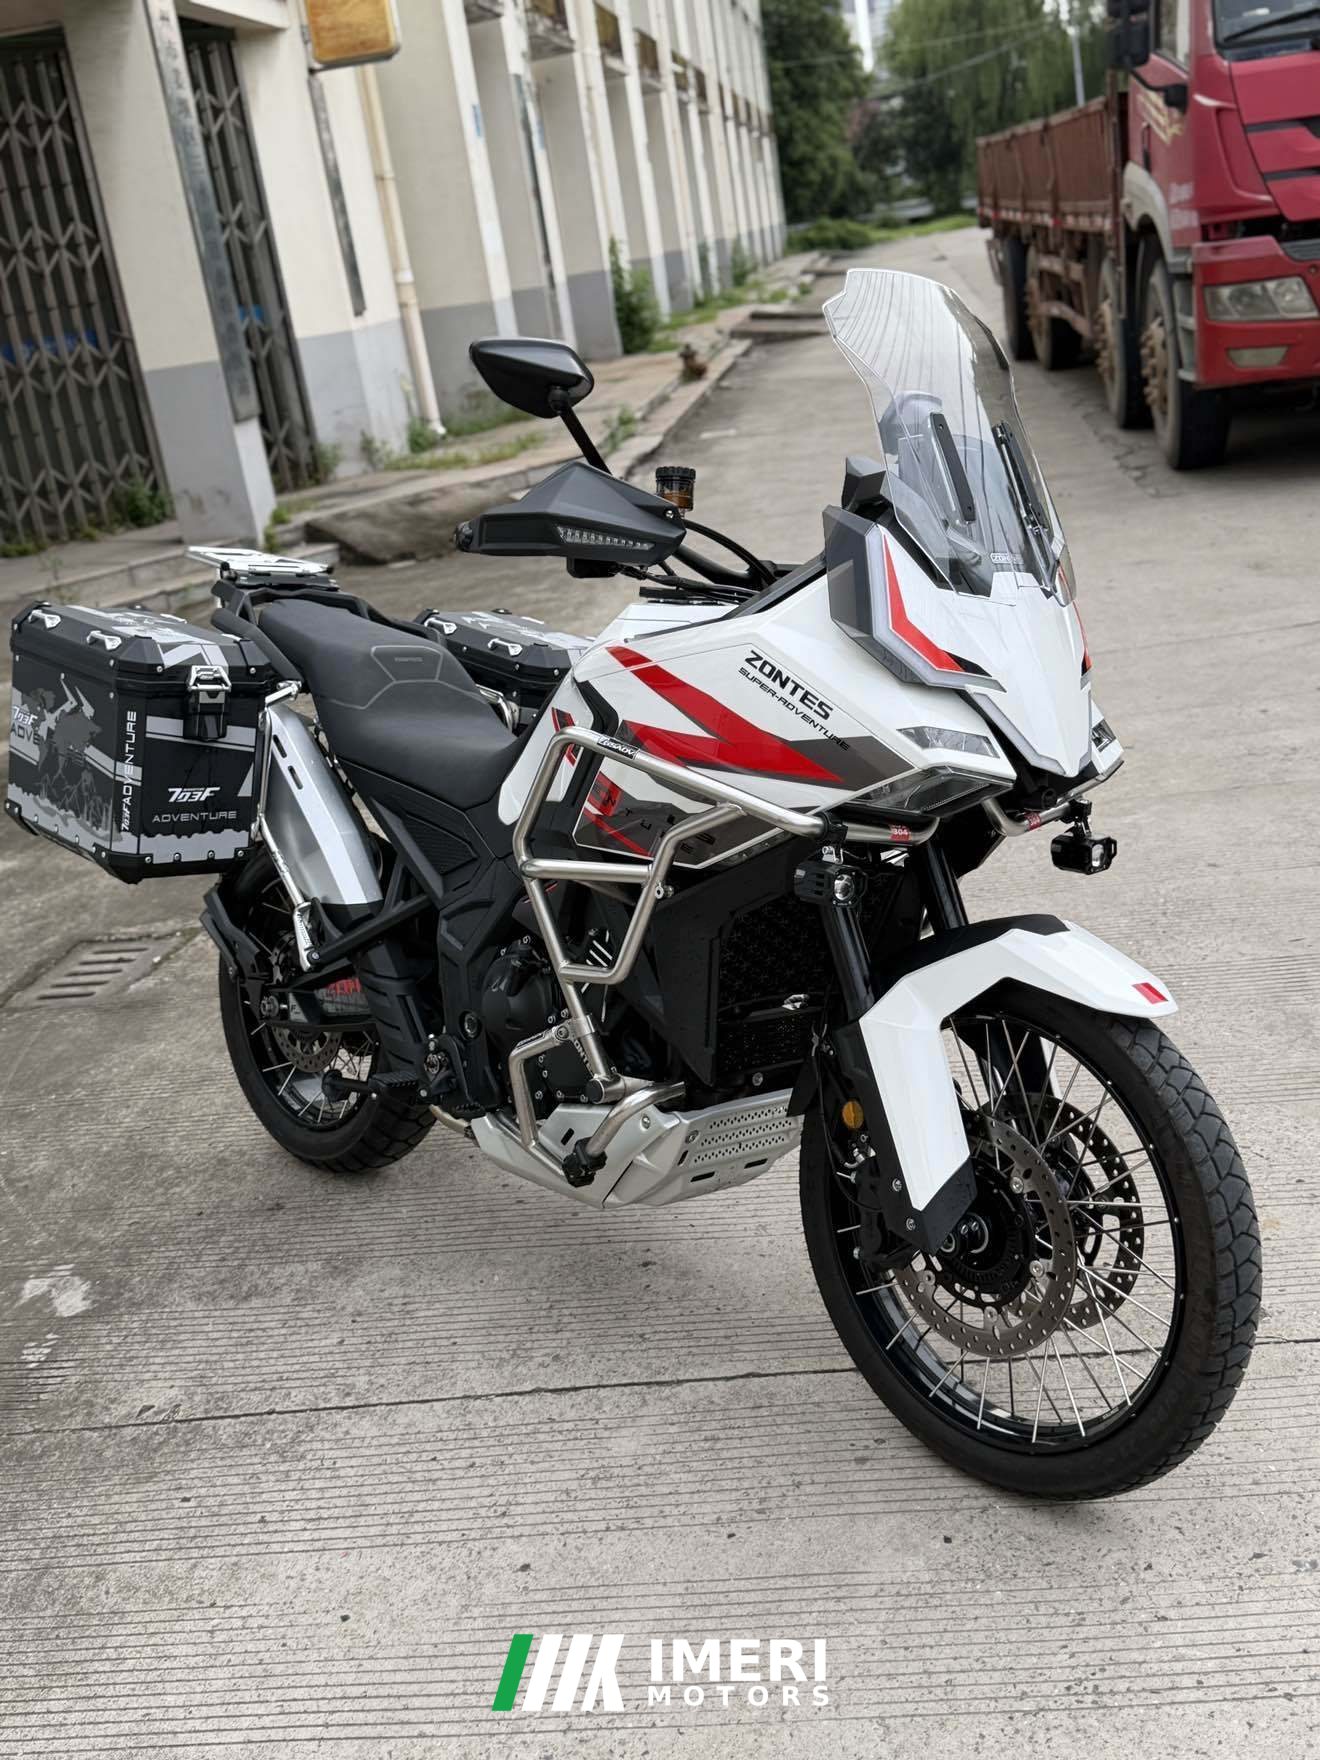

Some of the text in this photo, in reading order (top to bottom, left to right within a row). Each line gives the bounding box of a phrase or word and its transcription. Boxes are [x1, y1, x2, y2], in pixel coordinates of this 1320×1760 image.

[738, 667, 851, 751] SUPER-ADVENTURE
[744, 650, 834, 722] ZONTES
[152, 811, 237, 824] ADVENTURE
